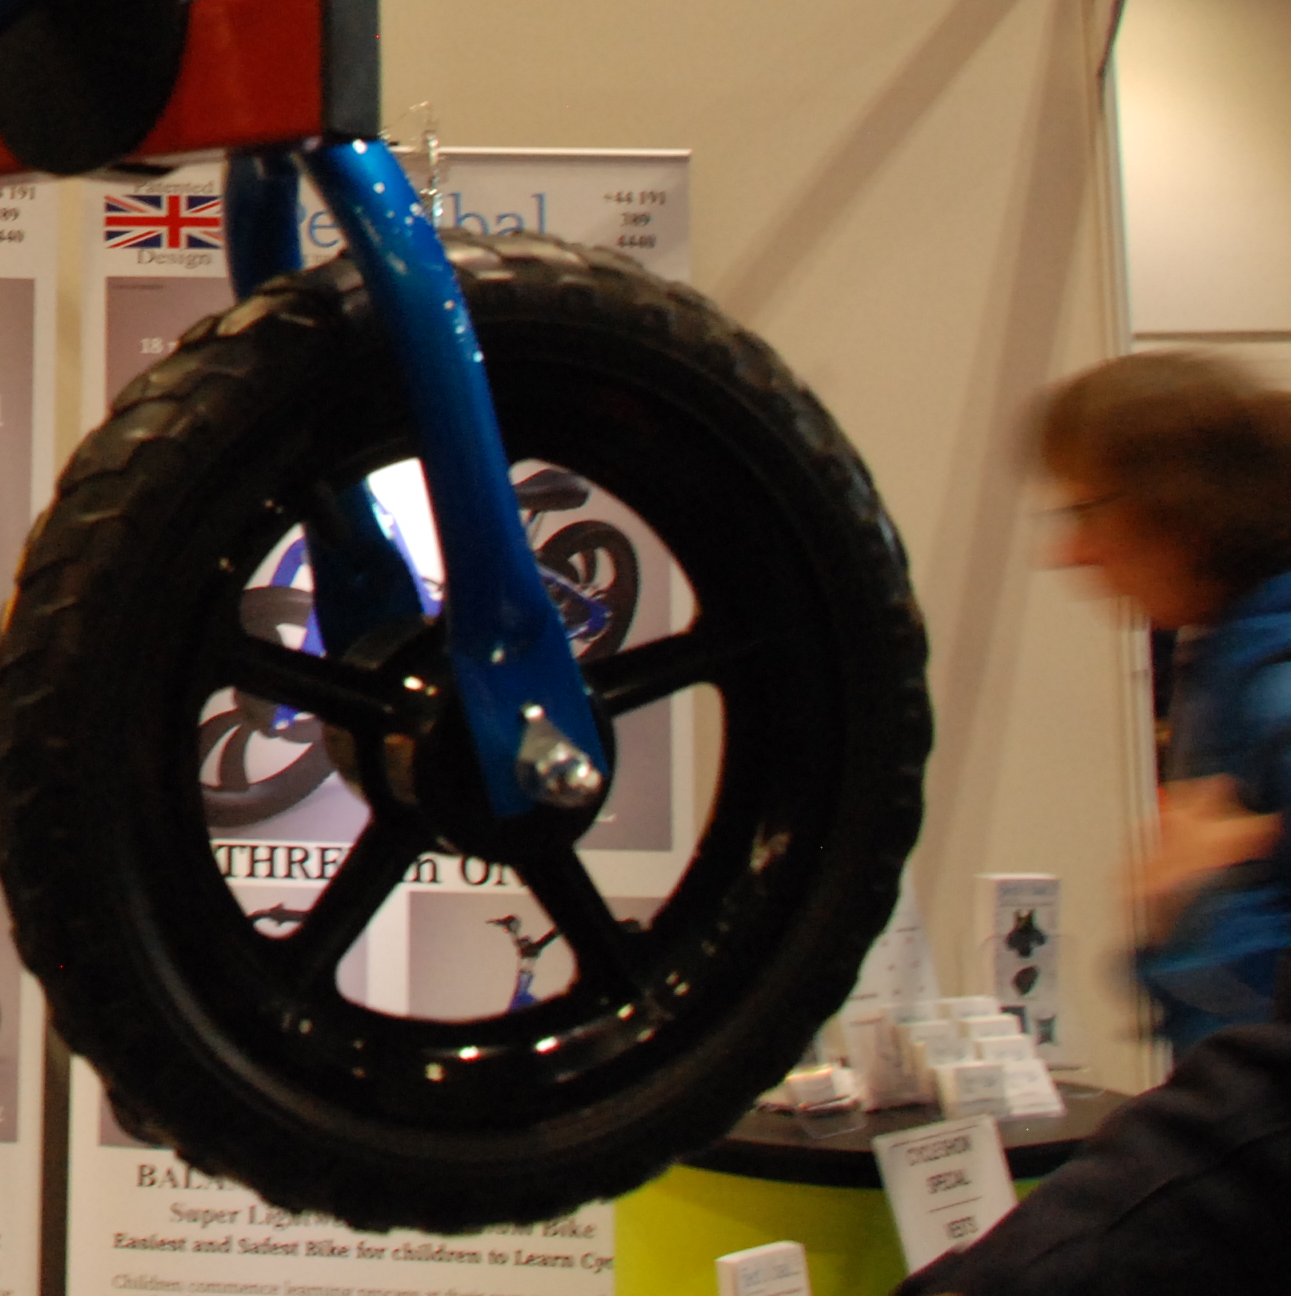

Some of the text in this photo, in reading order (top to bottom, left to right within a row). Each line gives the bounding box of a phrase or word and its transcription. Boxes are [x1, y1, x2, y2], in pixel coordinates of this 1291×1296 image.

[136, 249, 212, 269] Design
[214, 844, 346, 881] THRE
[169, 1202, 241, 1229] Super
[113, 1232, 187, 1251] Easiest
[192, 1235, 233, 1254] and
[237, 1237, 299, 1255] Safest
[305, 1240, 350, 1258] Bike
[356, 1240, 387, 1260] for
[391, 1242, 483, 1264] children
[488, 1250, 509, 1265] to
[514, 1250, 574, 1268] Learn
